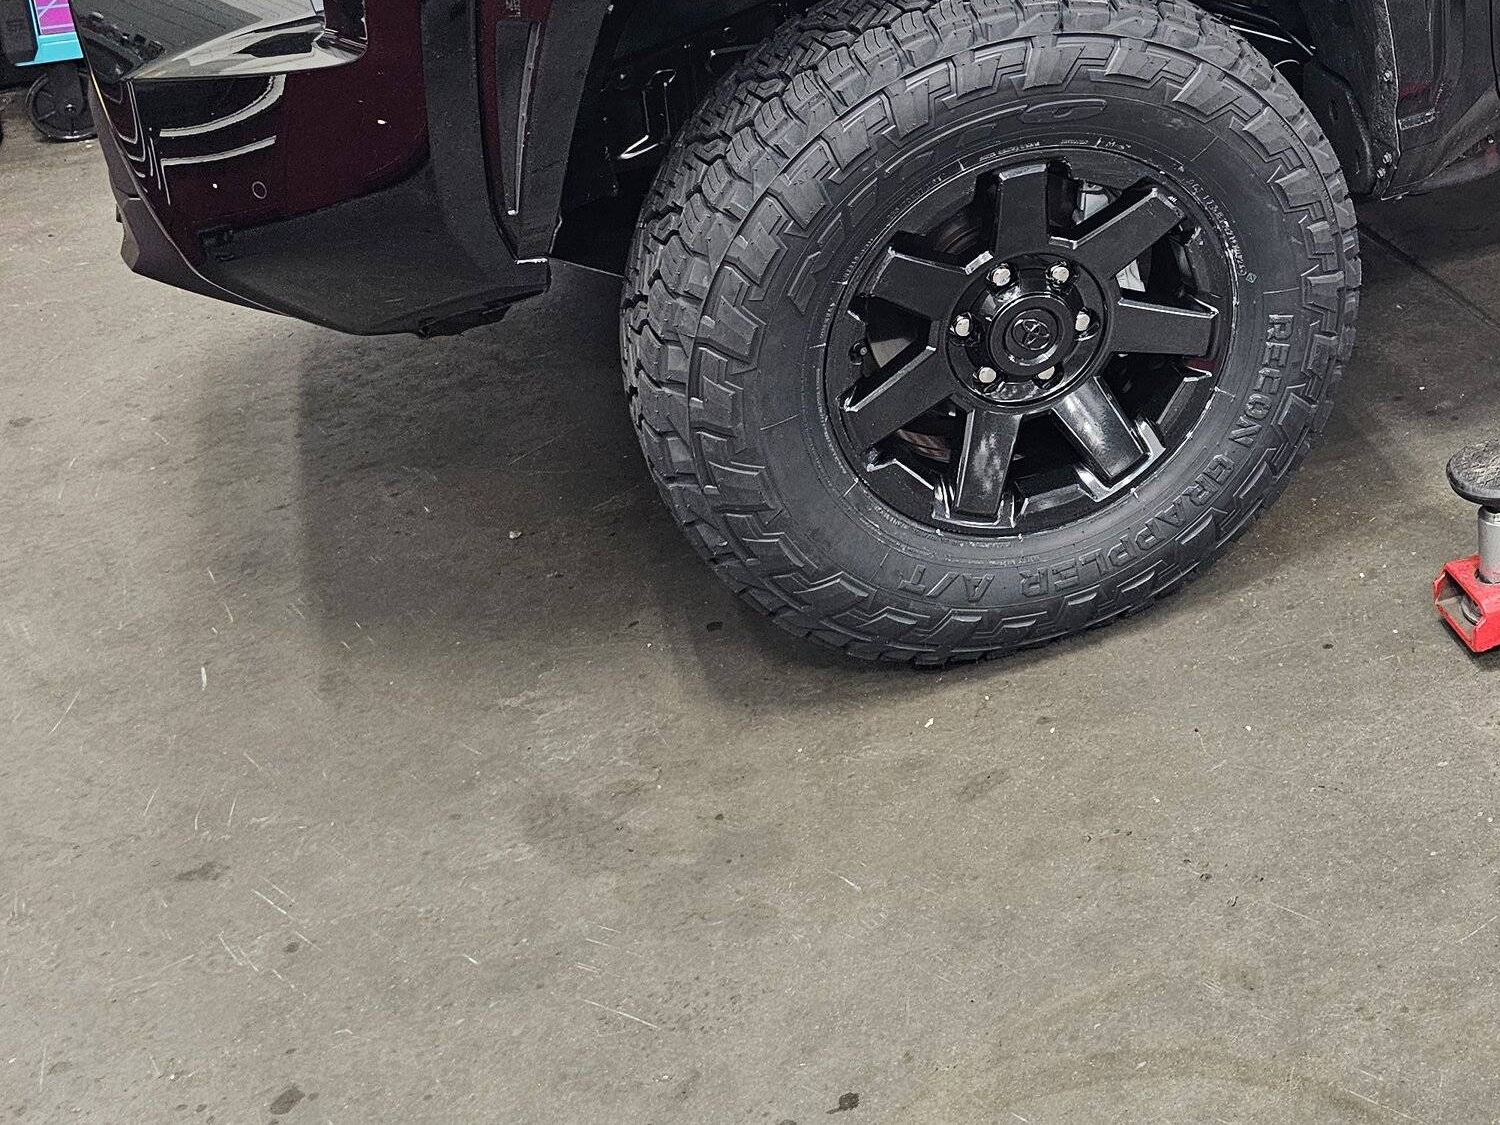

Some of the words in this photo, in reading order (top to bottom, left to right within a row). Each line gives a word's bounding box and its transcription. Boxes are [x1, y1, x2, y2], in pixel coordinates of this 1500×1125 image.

[1229, 313, 1295, 449] RECON
[897, 563, 995, 605] A/T
[1017, 453, 1235, 600] GRAPPLER
